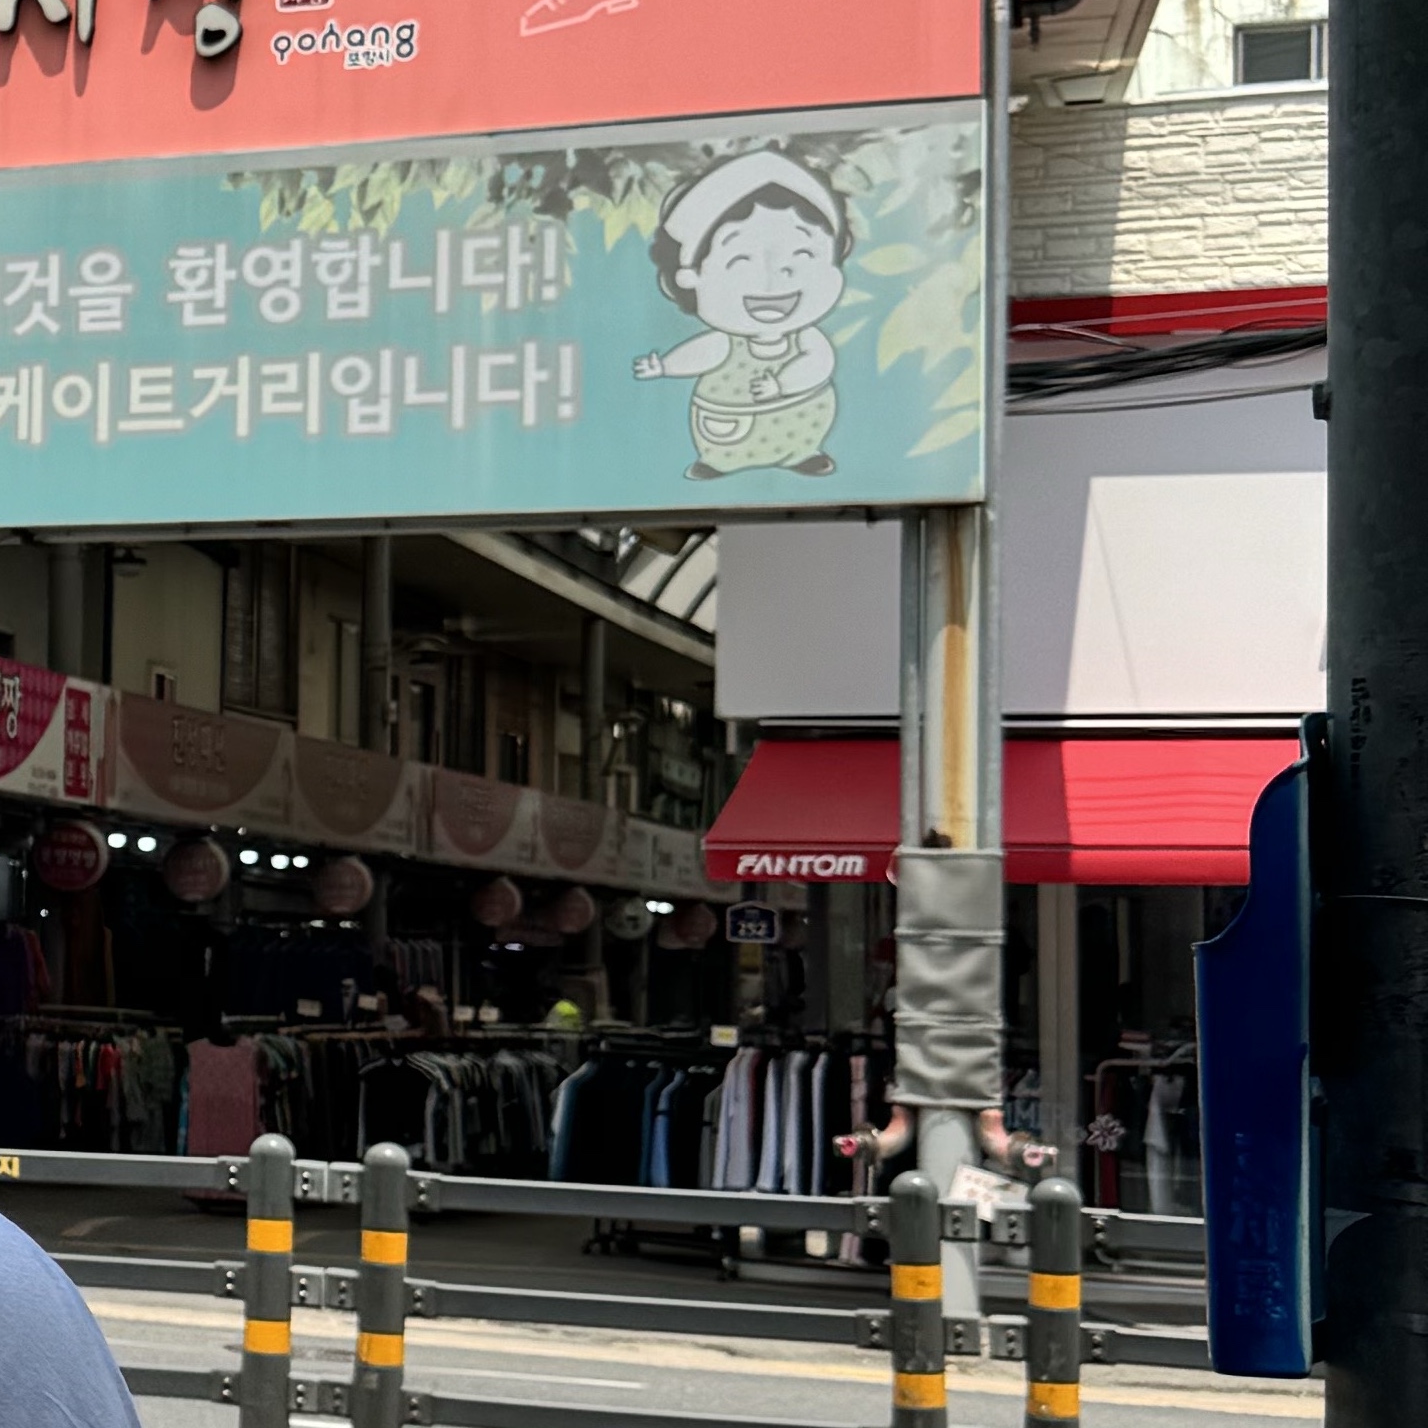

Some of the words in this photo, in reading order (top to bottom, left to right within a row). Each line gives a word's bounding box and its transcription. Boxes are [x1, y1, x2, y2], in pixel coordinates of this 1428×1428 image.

[273, 22, 416, 62] pohang
[166, 225, 561, 328] 환영합니다!
[736, 853, 868, 877] FANTOM
